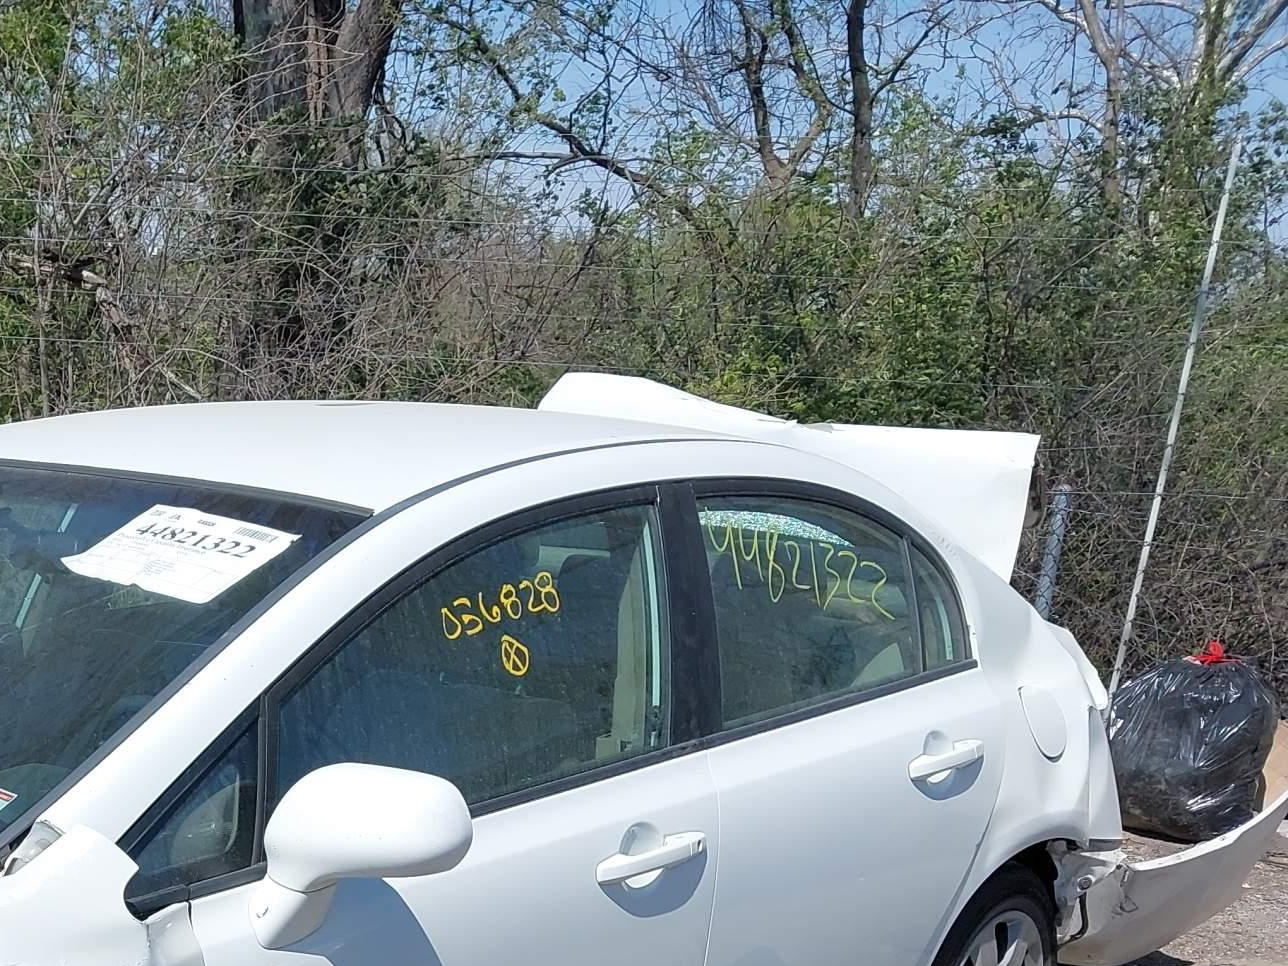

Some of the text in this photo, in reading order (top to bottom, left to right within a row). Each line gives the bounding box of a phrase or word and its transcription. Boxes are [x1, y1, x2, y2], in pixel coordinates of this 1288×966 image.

[135, 522, 257, 558] 44821322
[704, 507, 896, 621] 44821322
[440, 571, 560, 640] 036828
